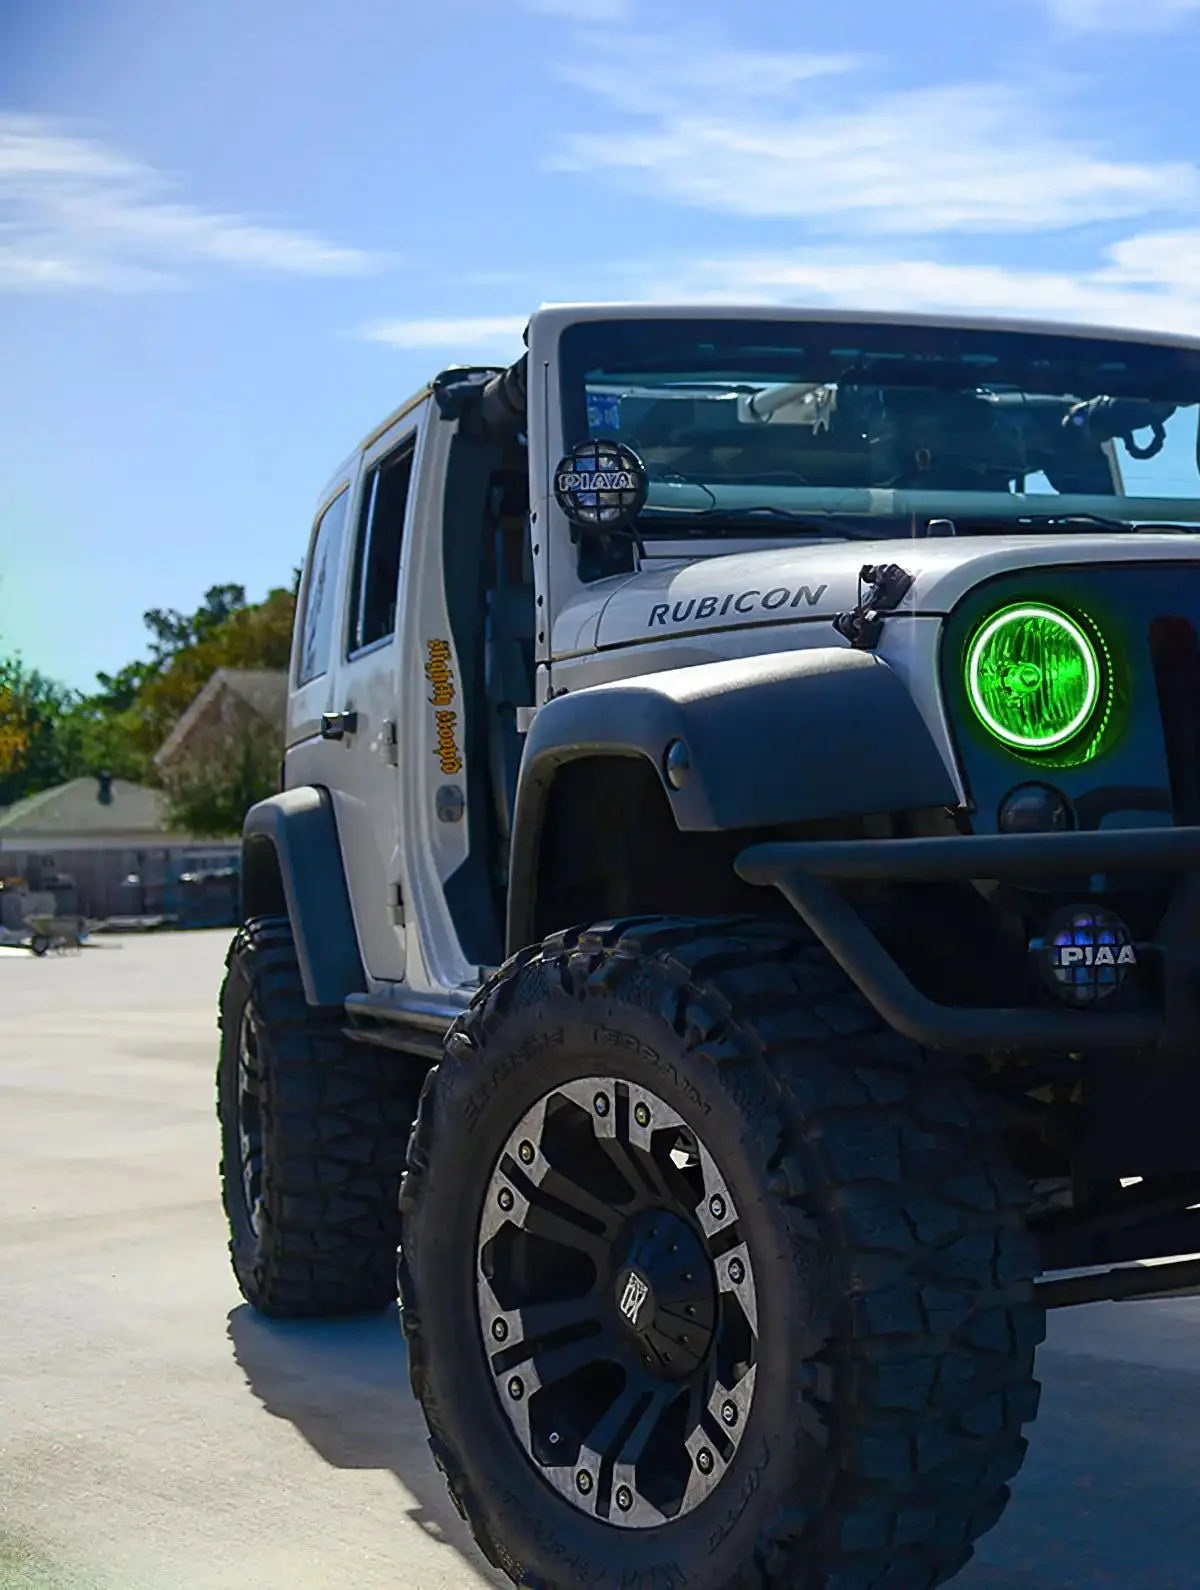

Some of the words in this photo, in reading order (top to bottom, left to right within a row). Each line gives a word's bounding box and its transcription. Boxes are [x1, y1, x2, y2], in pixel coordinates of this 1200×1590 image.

[558, 471, 635, 491] PIAA
[648, 584, 828, 628] RUBICON
[1061, 944, 1137, 966] PIAA
